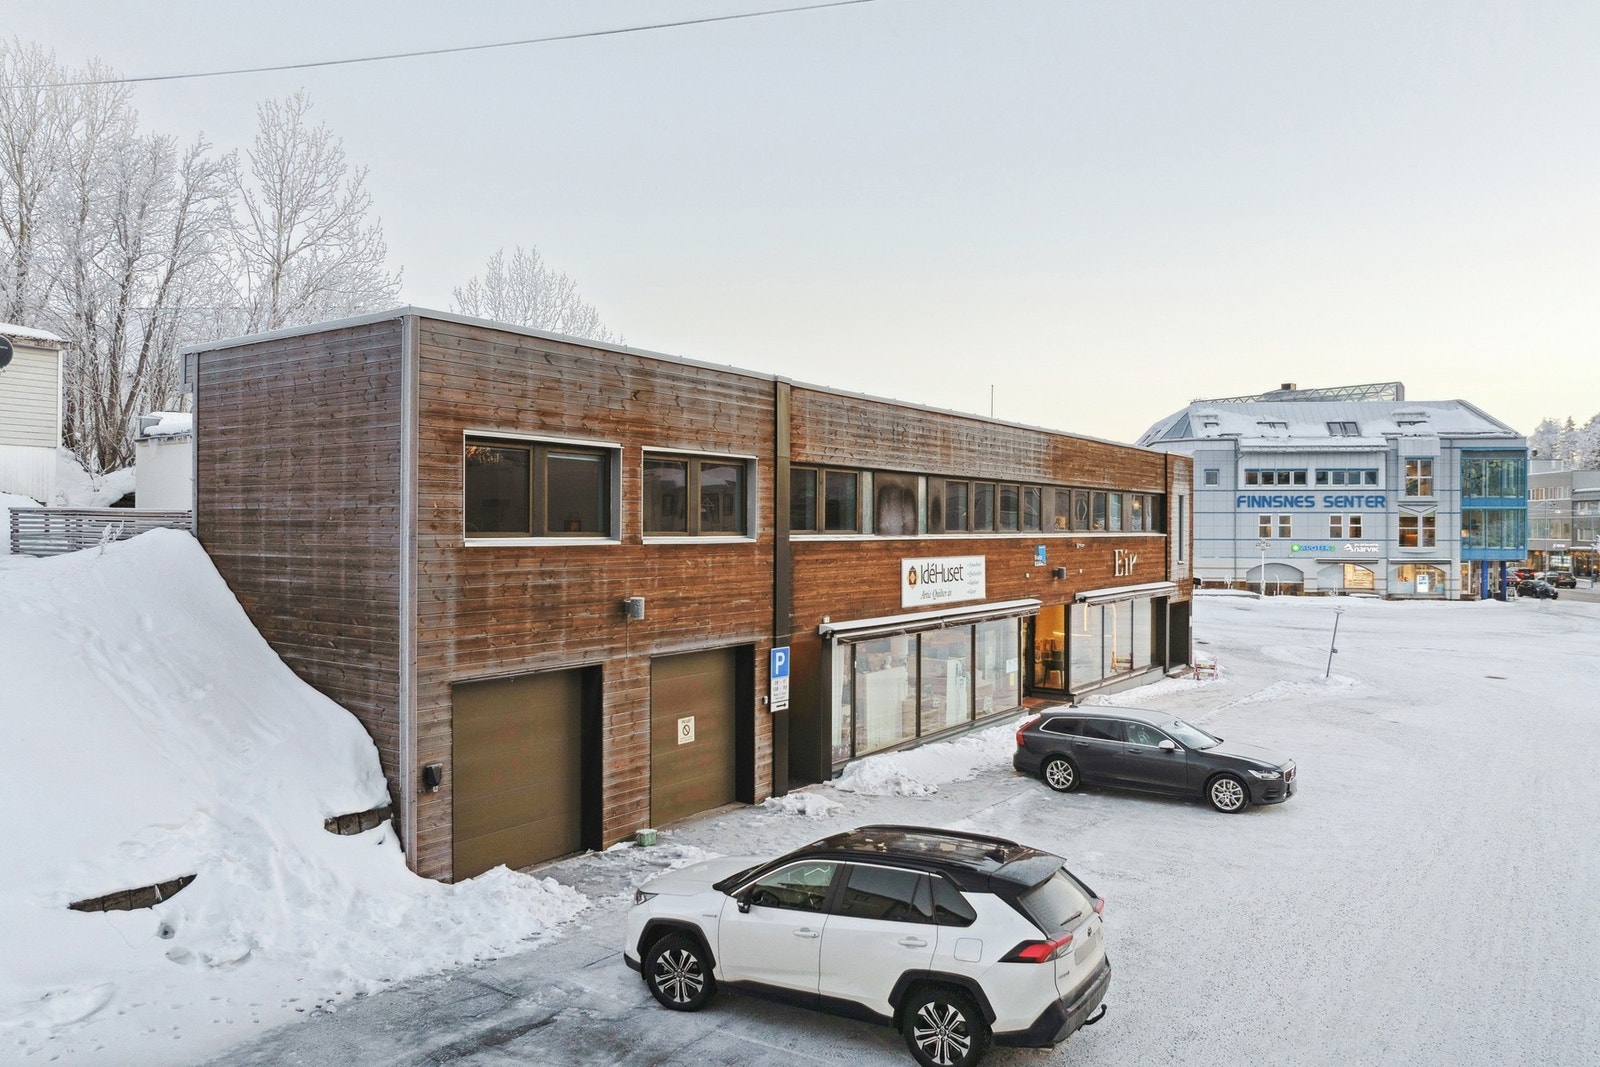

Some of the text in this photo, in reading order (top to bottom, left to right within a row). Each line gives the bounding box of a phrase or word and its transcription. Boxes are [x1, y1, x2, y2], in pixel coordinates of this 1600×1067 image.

[1236, 495, 1386, 508] FINNSNES SENTER
[921, 563, 963, 584] IdéHuset
[1113, 549, 1138, 577] Eir
[776, 652, 785, 674] P
